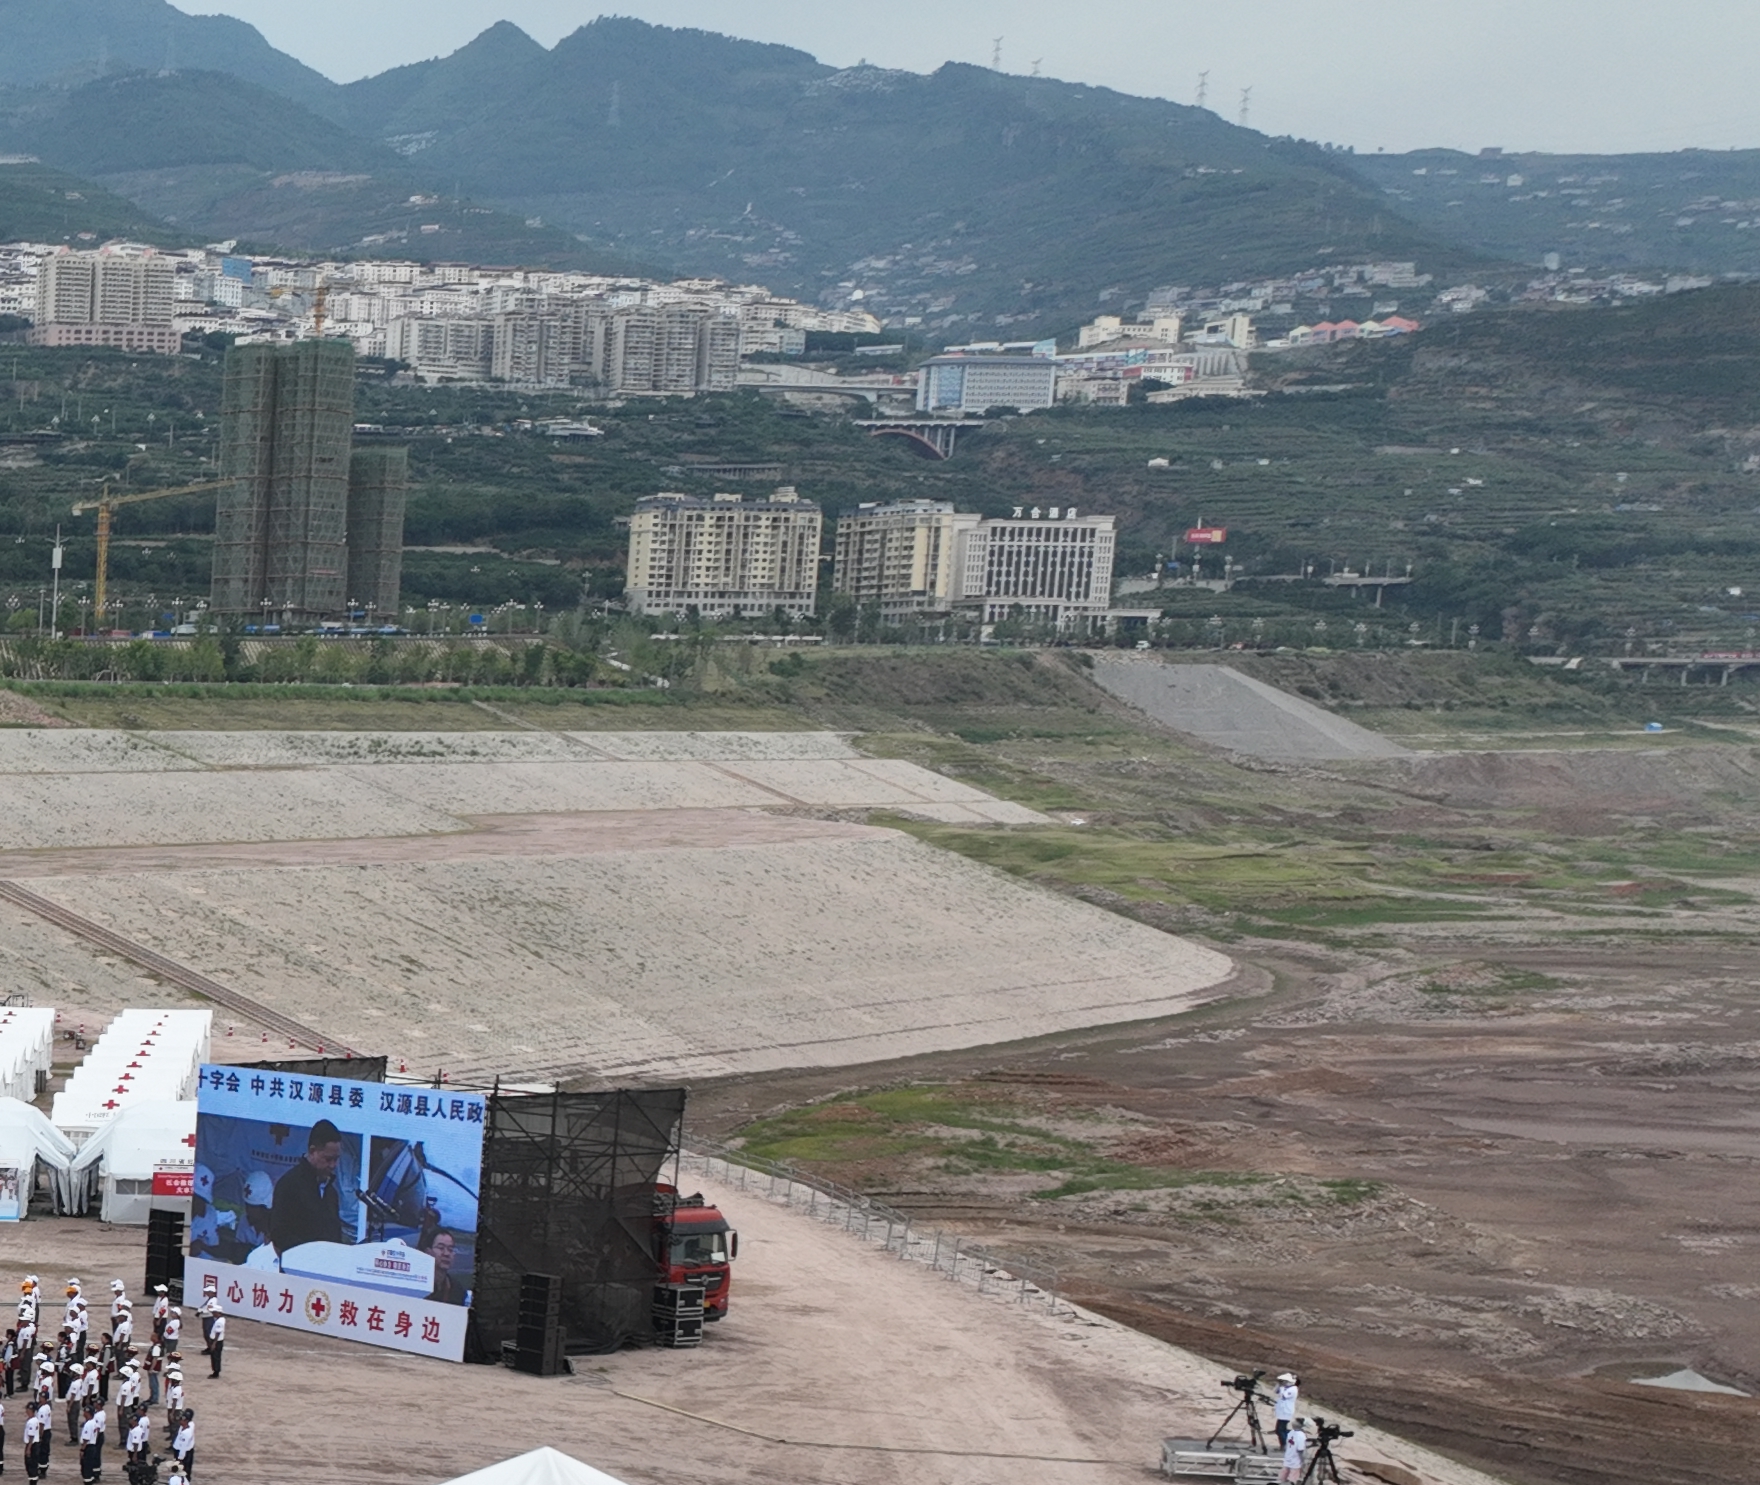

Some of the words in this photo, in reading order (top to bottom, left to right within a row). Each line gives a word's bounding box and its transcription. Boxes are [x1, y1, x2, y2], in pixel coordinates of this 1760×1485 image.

[251, 1079, 364, 1109] 中共汉源县委
[380, 1091, 484, 1123] 汉源县人民政
[203, 1274, 294, 1313] 同心协力
[339, 1300, 441, 1343] 救在身边
